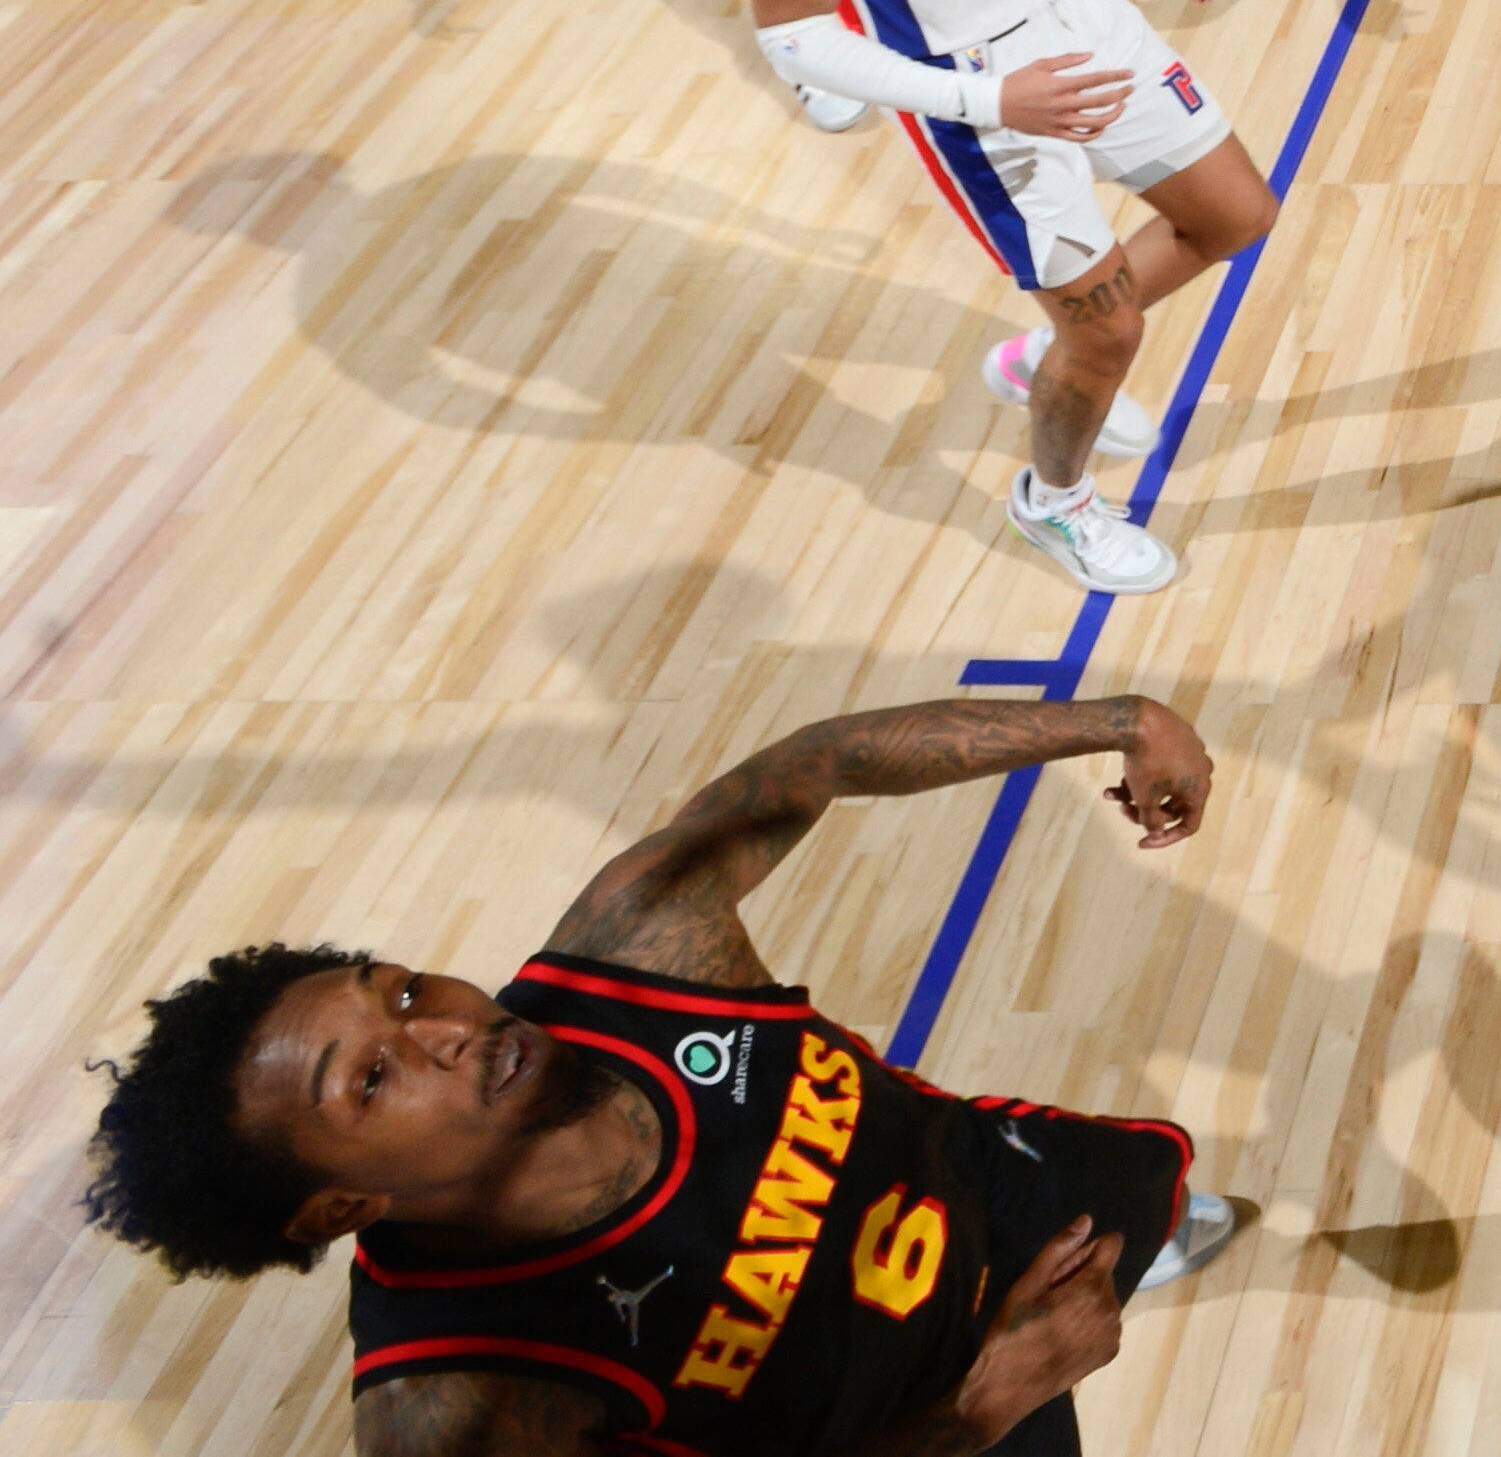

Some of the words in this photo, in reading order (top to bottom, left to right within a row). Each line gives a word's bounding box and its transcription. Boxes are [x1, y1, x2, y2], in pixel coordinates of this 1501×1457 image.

[731, 1024, 755, 1105] sharecare
[672, 1029, 862, 1402] HAWKS
[851, 1181, 949, 1322] 6
